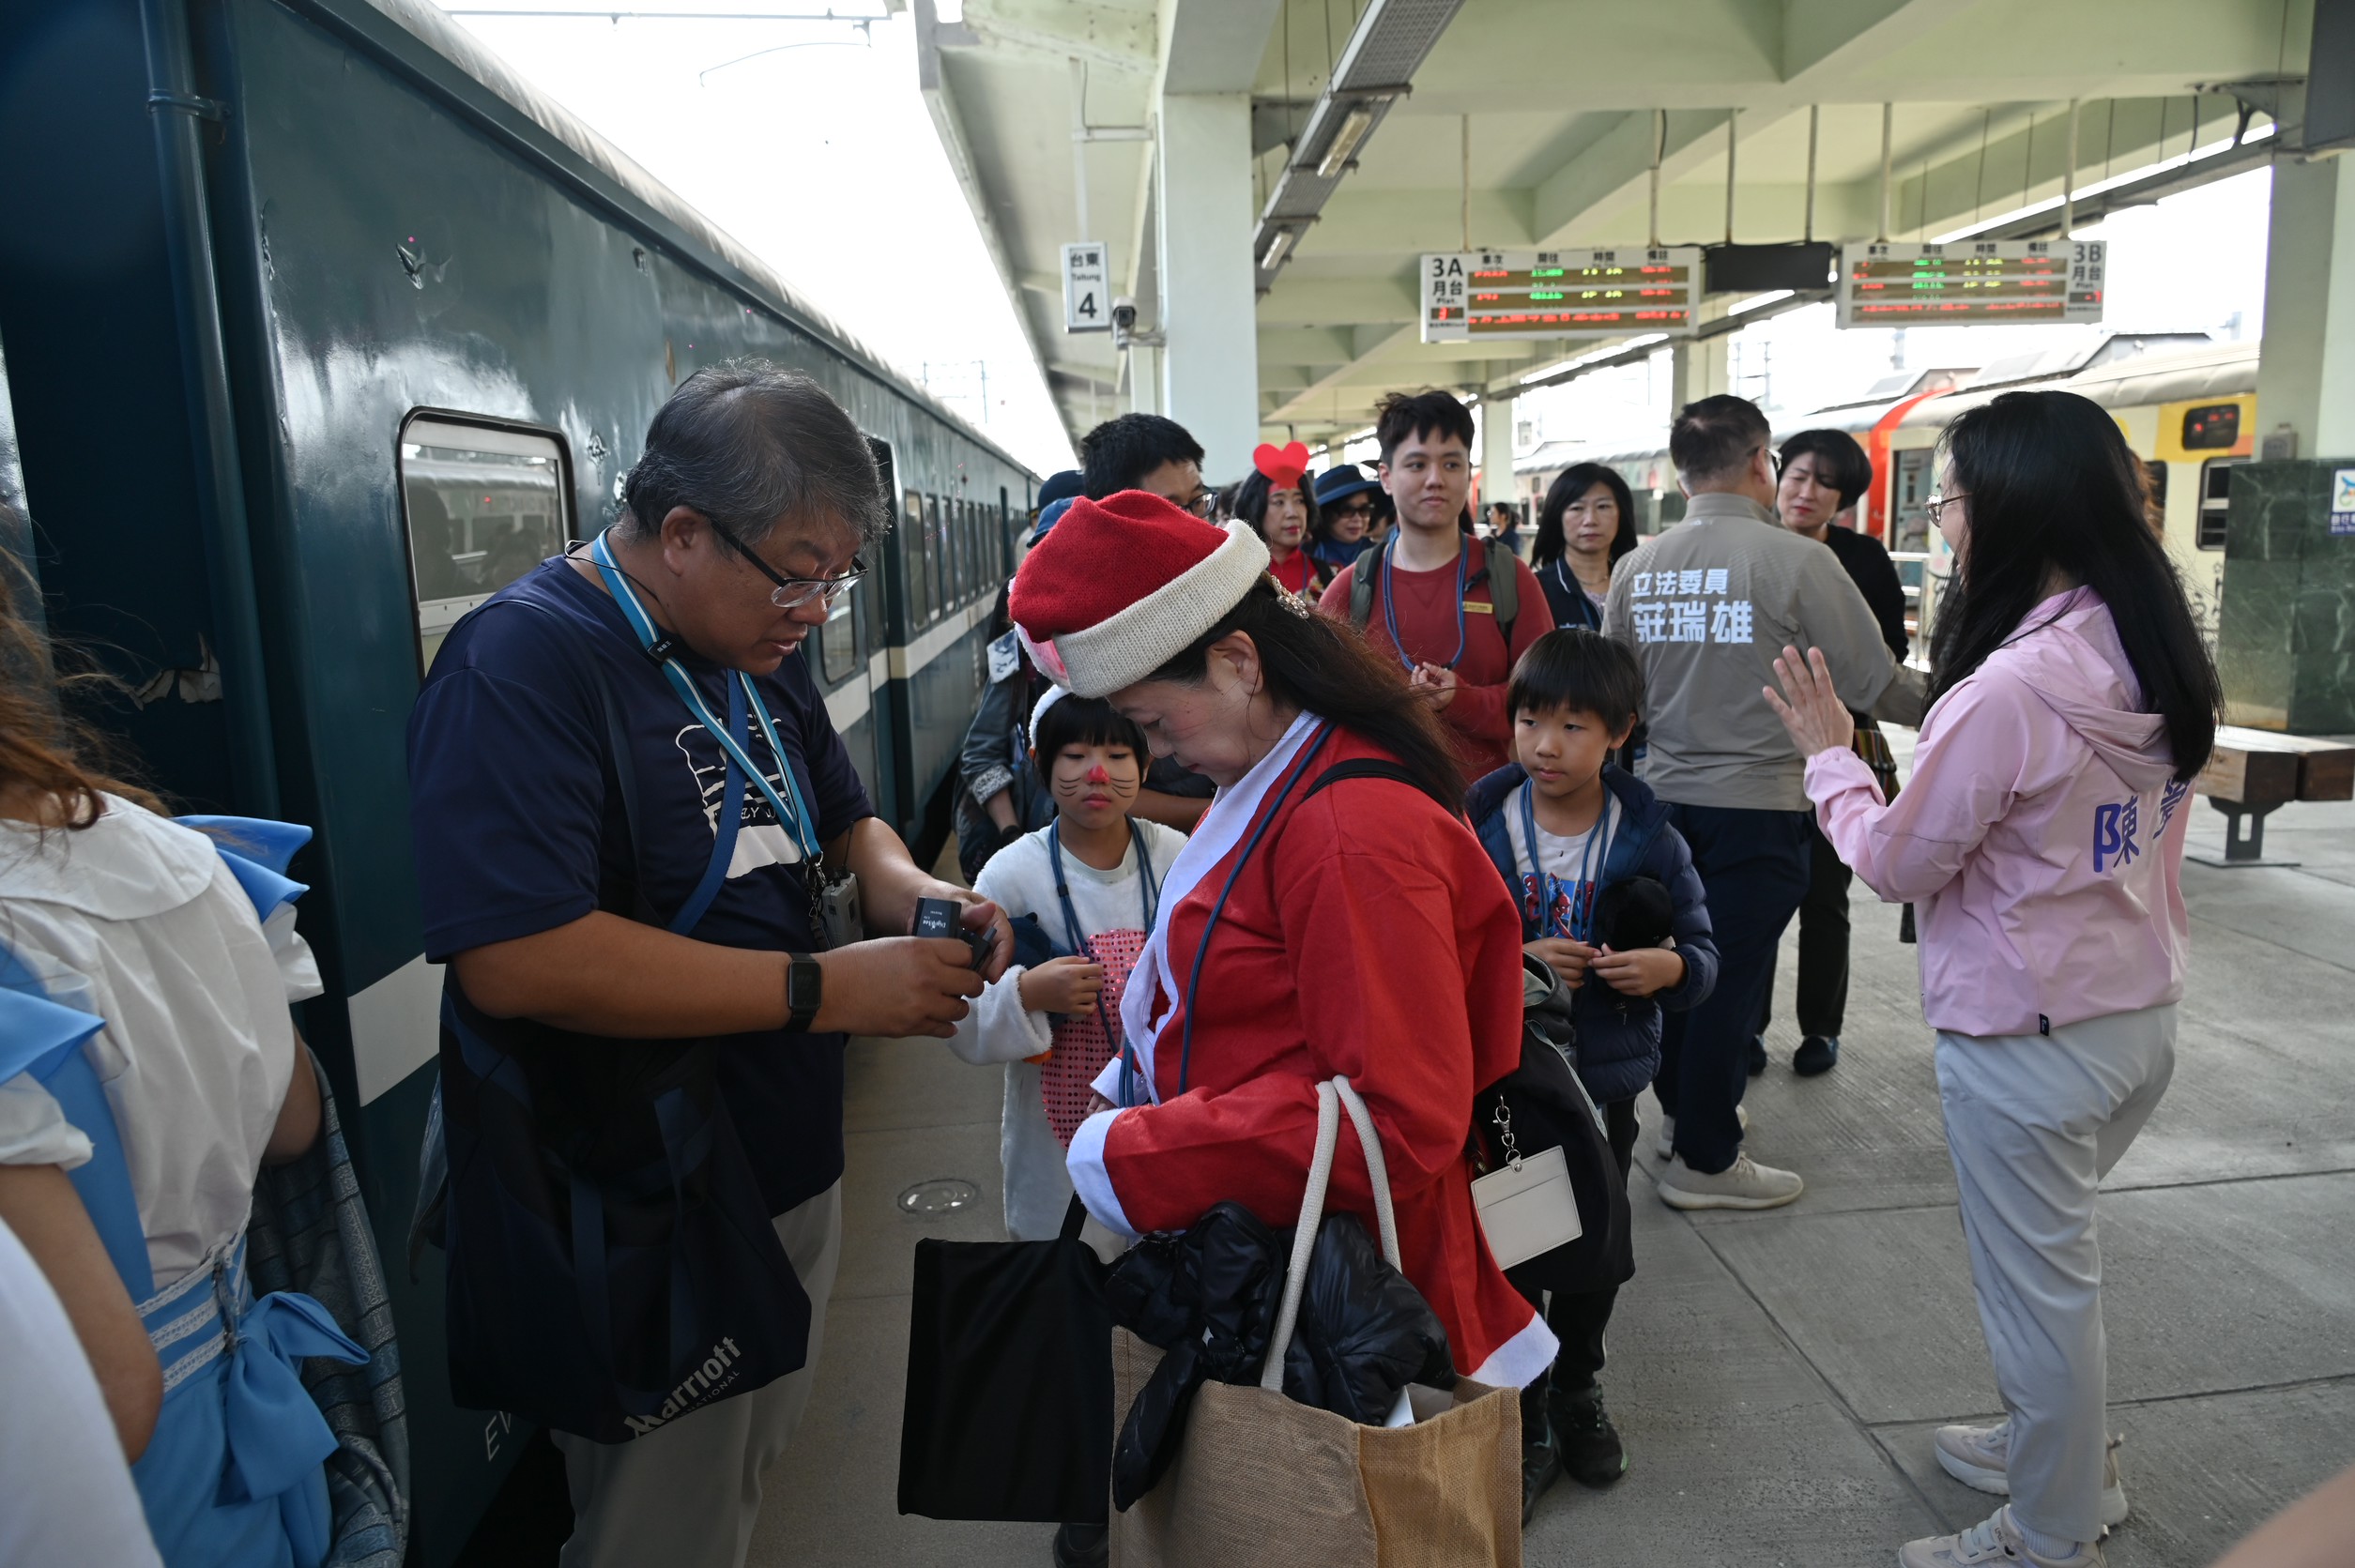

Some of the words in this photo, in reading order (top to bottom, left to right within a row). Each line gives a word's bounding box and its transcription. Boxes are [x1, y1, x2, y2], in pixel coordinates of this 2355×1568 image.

[1070, 252, 1099, 267] 台東
[2073, 244, 2103, 264] 3B
[1432, 257, 1463, 278] 3A
[2072, 264, 2102, 281] 月台
[1432, 279, 1462, 296] 月台
[1078, 292, 1097, 319] 4
[1630, 569, 1728, 598] 立法委員
[1631, 601, 1753, 644] 莊瑞雄
